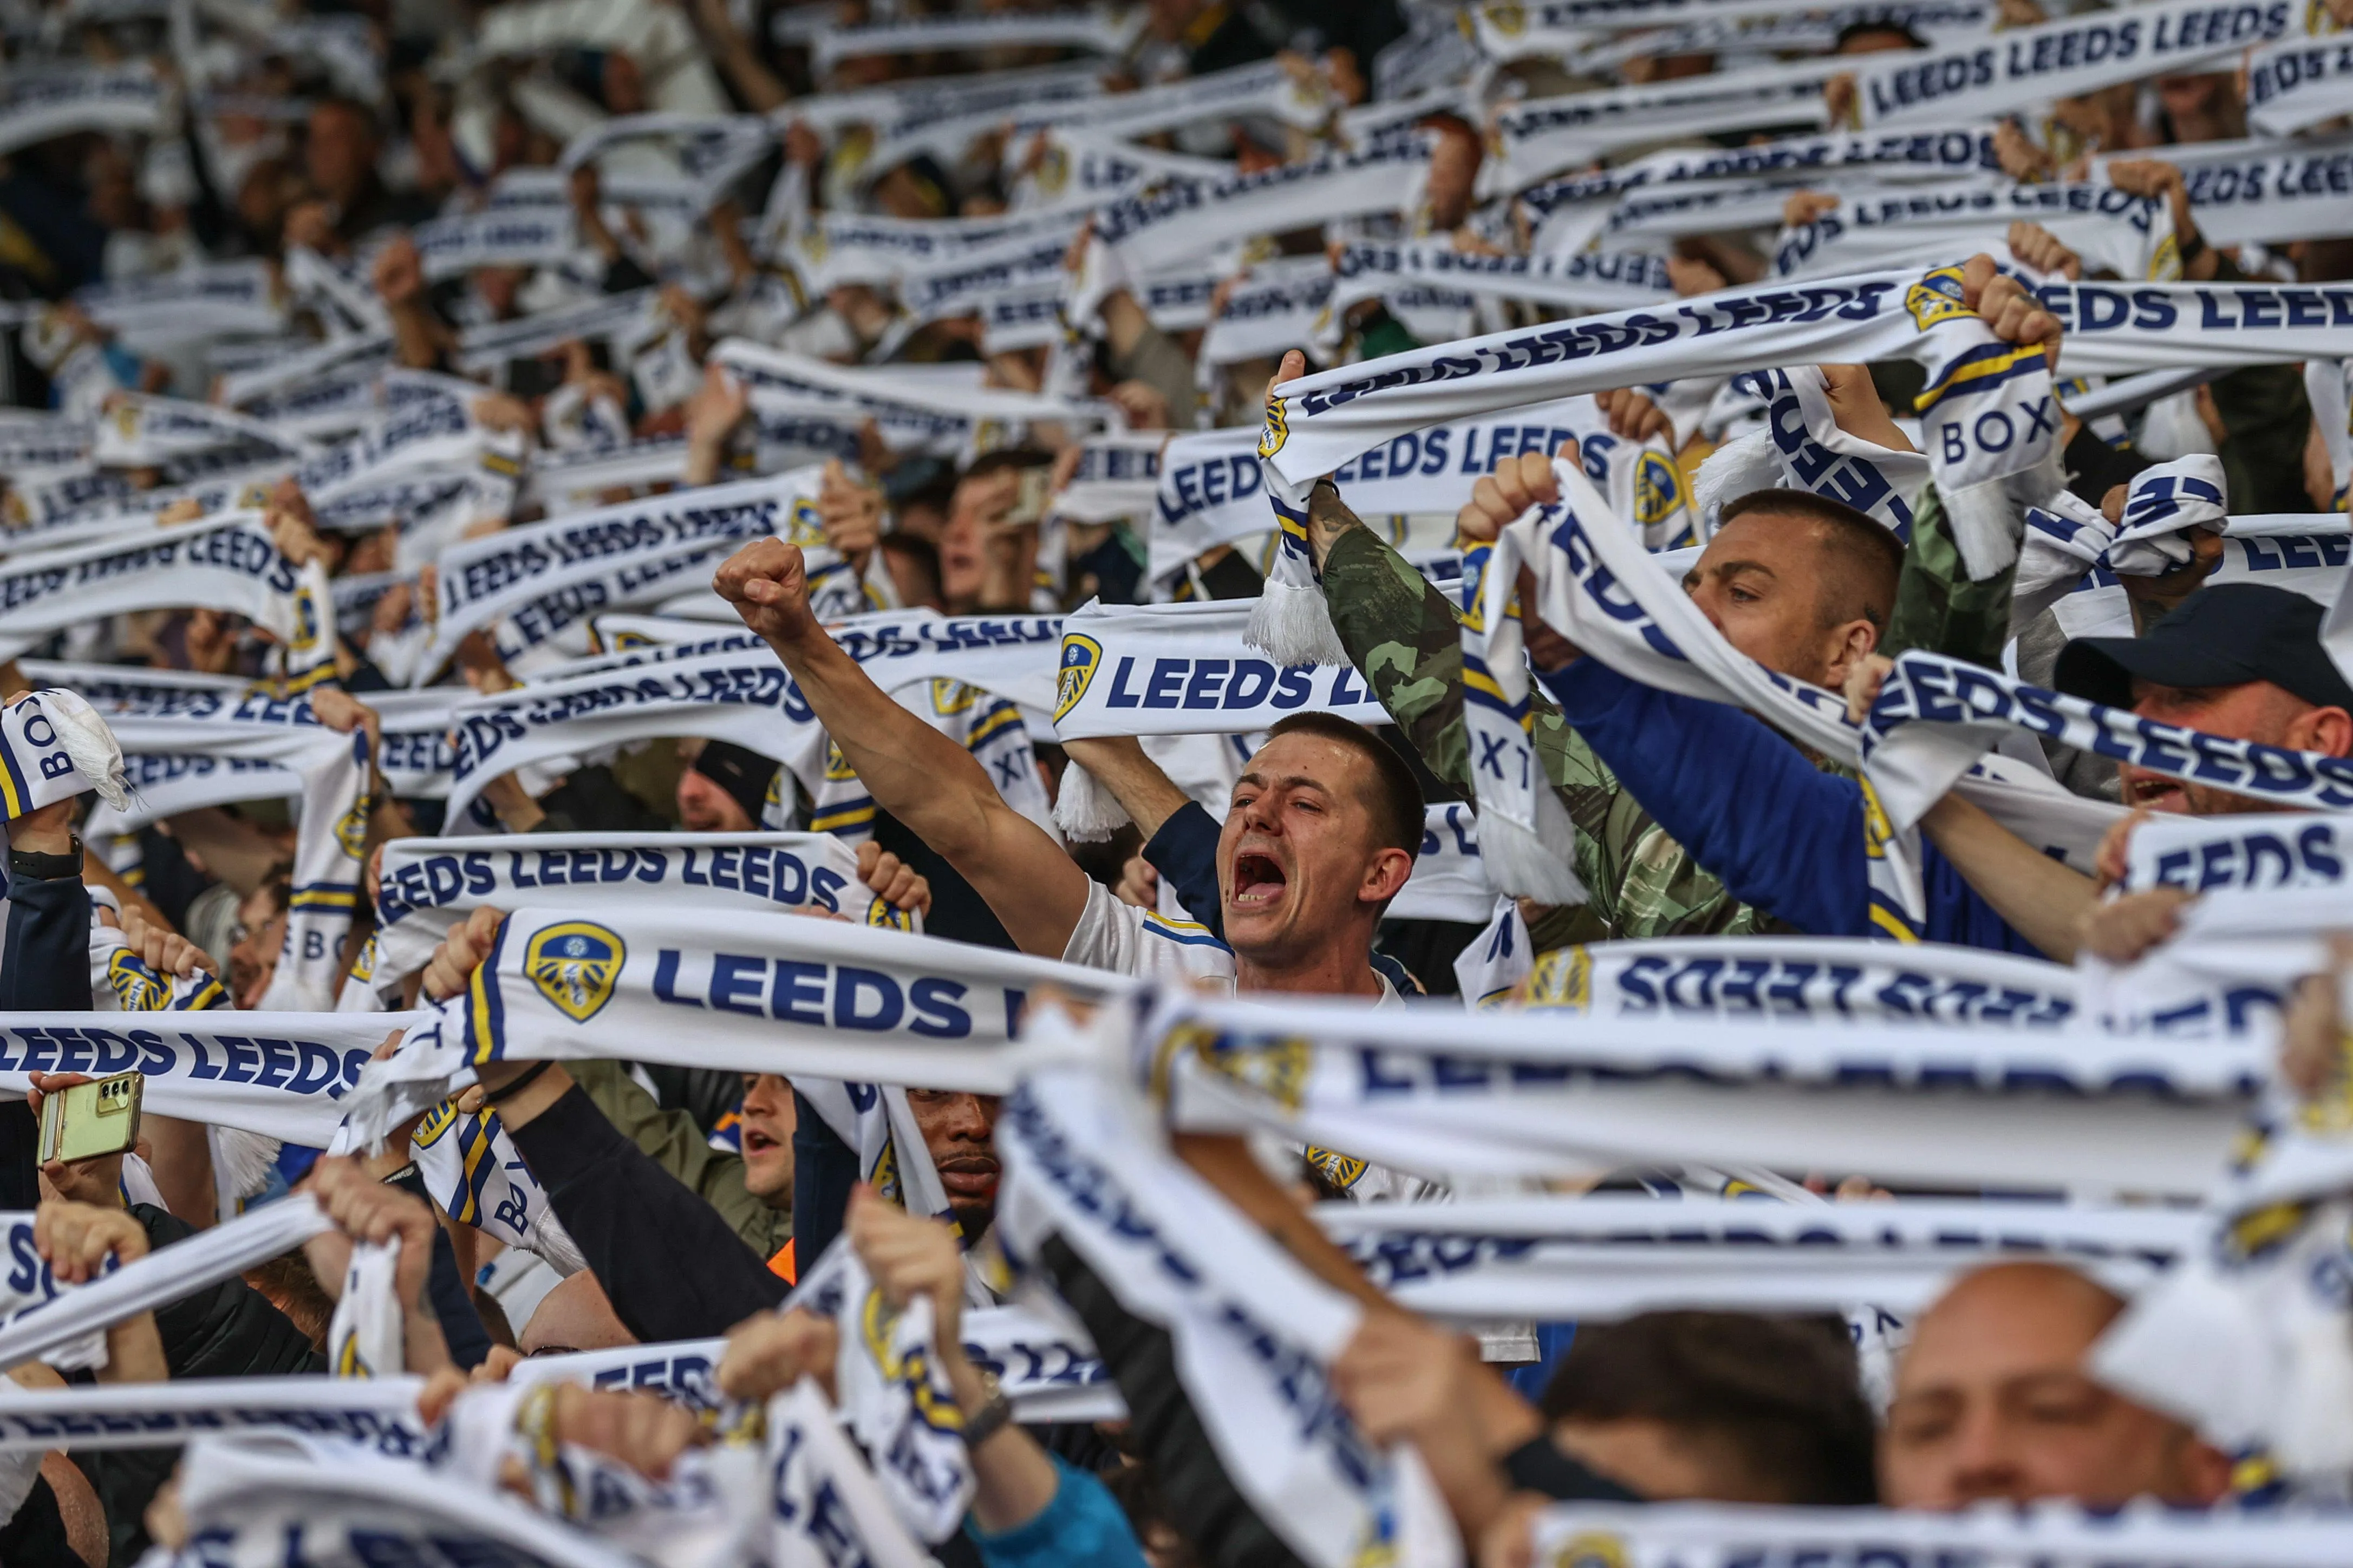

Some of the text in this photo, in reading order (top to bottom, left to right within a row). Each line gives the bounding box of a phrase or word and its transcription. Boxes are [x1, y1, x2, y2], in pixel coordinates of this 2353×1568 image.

[1870, 48, 1994, 116] LEEDS
[2010, 21, 2139, 77] LEEDS
[2154, 3, 2290, 50] LEEDS
[2277, 154, 2353, 197] LEE
[1476, 313, 1679, 374] LEEDS
[1679, 282, 1895, 336] LEEDS
[1941, 396, 2055, 465] BOX
[1106, 657, 1317, 709] LEEDS
[507, 848, 668, 890] LEEDS
[681, 847, 849, 913] LEEDS
[652, 949, 972, 1038] LEEDS
[0, 1028, 372, 1100] LEEDS LEEDS
